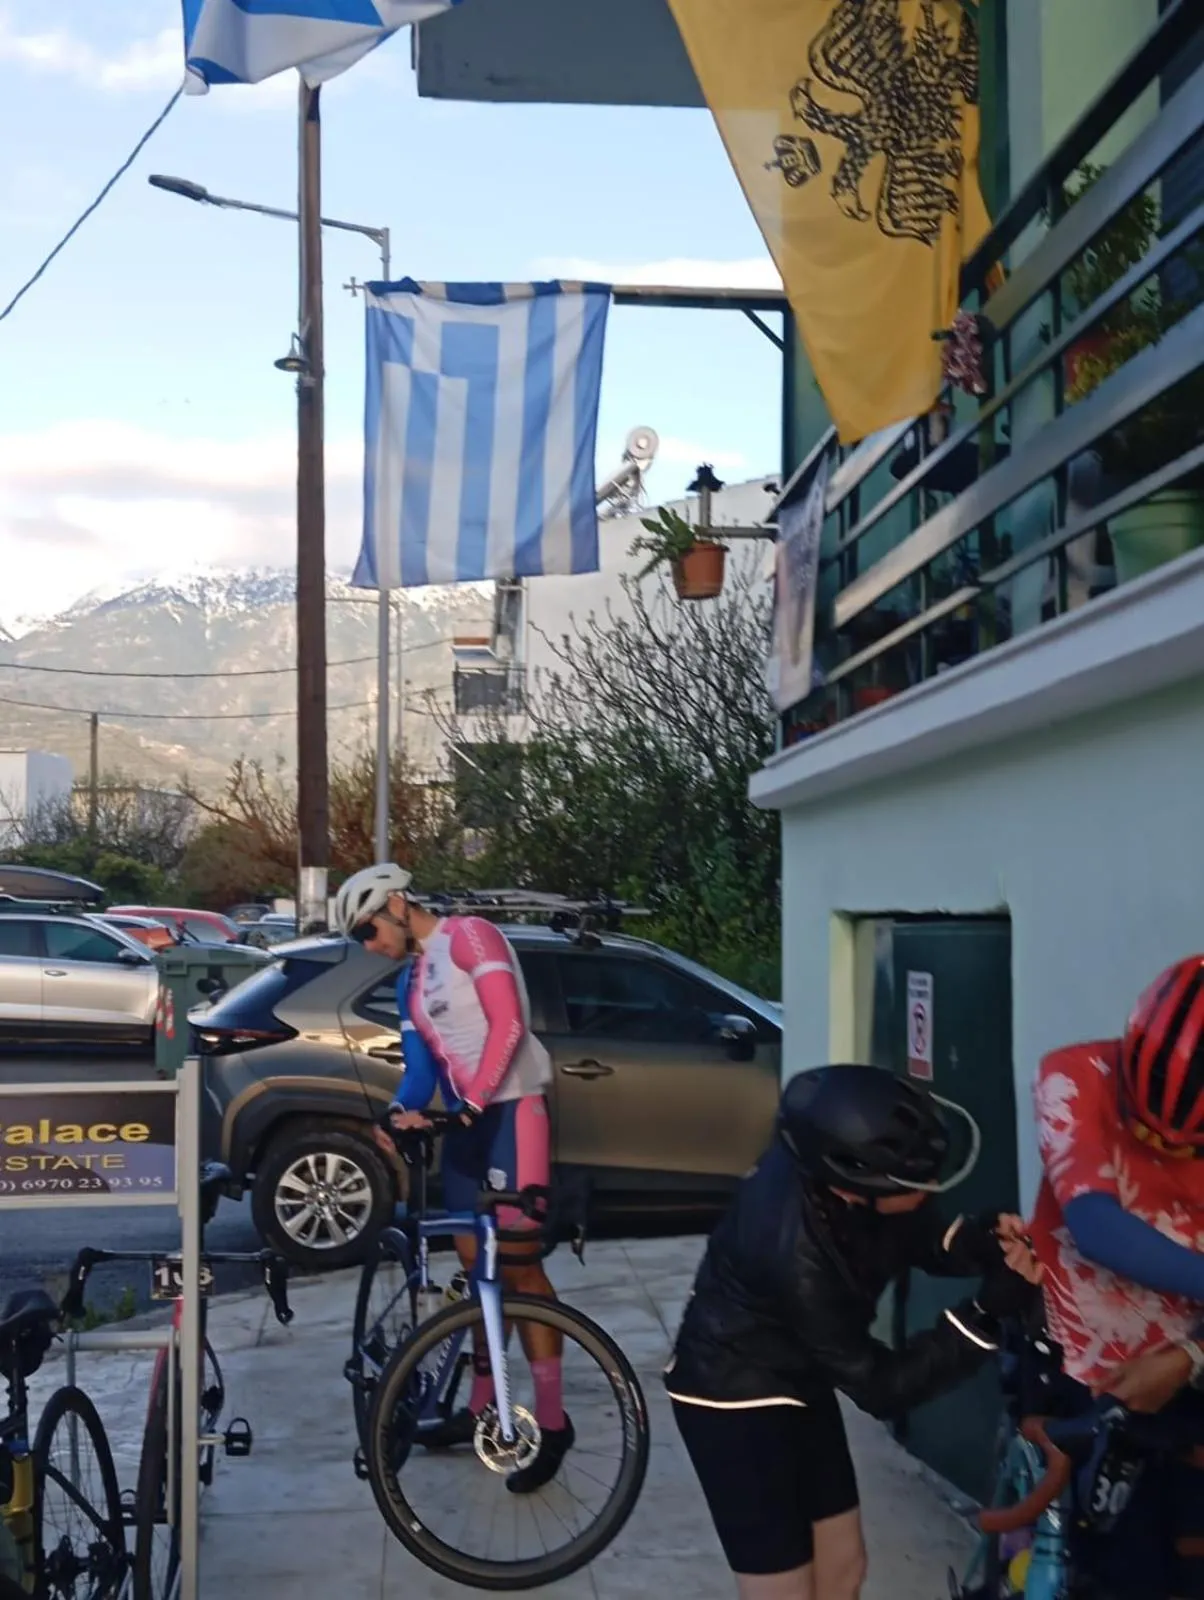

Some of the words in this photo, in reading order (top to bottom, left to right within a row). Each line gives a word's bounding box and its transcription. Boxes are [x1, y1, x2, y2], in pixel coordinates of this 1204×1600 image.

[0, 1119, 150, 1145] alace
[0, 1154, 126, 1171] STATE
[21, 1178, 73, 1190] 6970
[78, 1177, 102, 1189] 23
